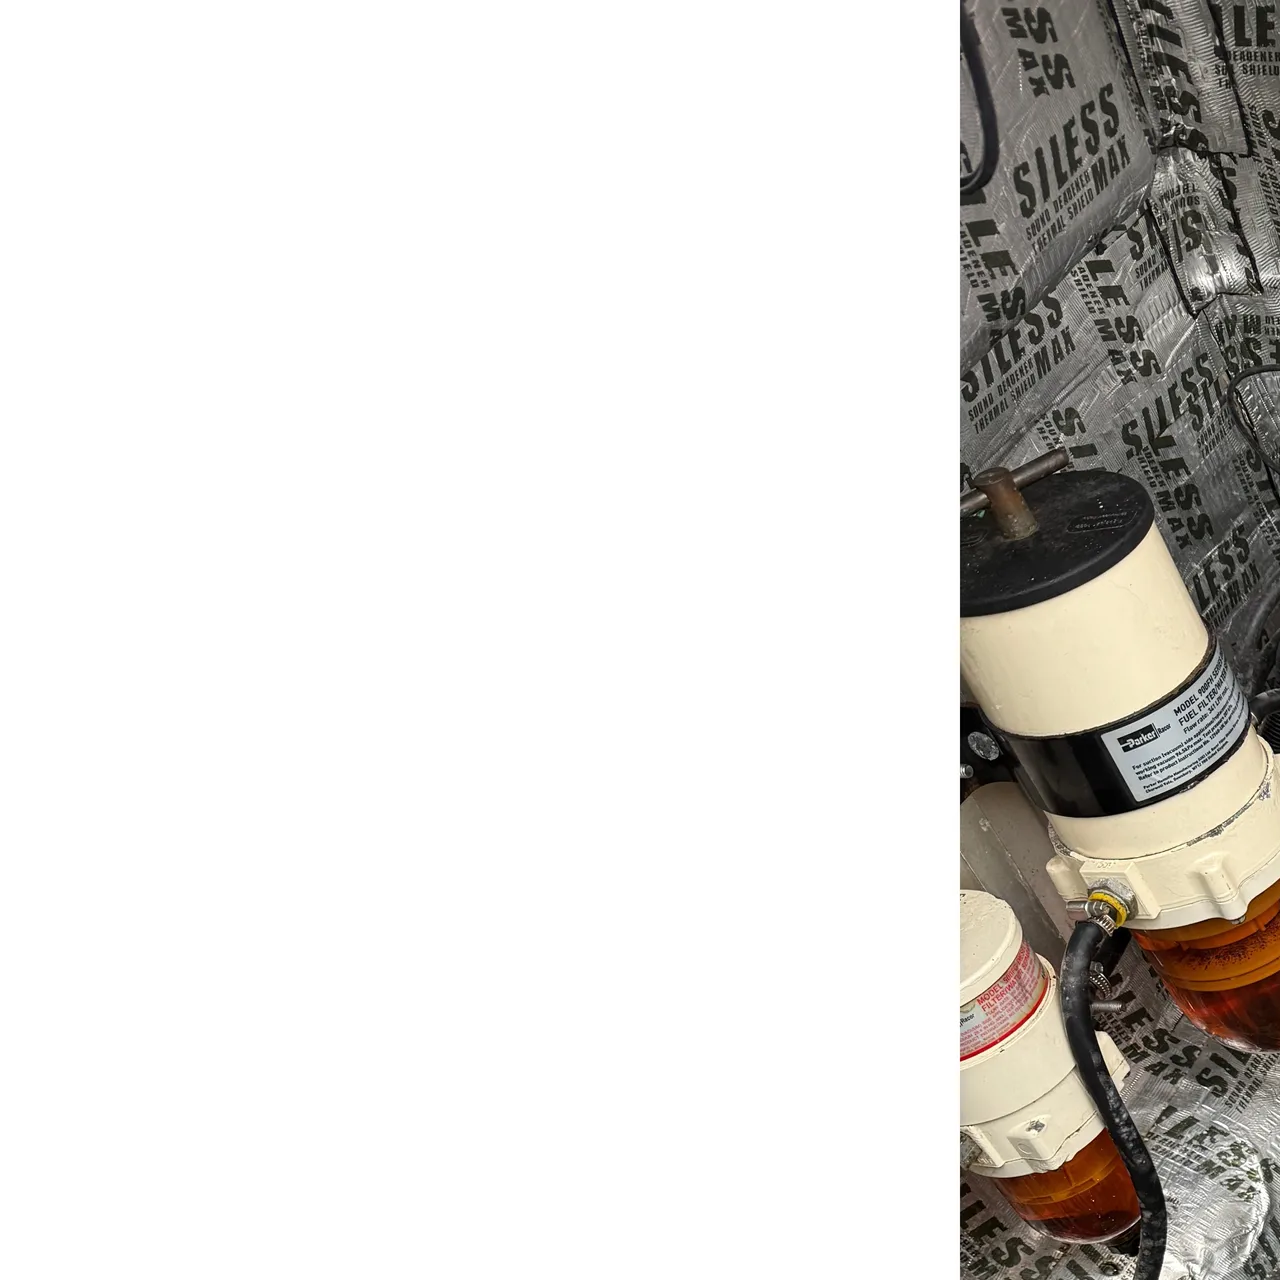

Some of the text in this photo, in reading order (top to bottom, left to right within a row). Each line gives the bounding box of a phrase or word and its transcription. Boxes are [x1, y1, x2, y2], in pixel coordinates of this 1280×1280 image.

[1001, 7, 1050, 98] MAX
[1228, 51, 1280, 63] EADENER
[1242, 64, 1280, 76] SHIELD
[1014, 82, 1119, 219] SILESS
[1026, 208, 1051, 241] SOUND
[1091, 134, 1131, 197] MAX
[1085, 259, 1161, 378] LESS
[968, 386, 994, 421] SOUND
[1034, 326, 1075, 380] MAX
[974, 400, 1009, 434] THERMAL
[1173, 693, 1198, 716] MODEL
[1178, 709, 1199, 726] FUEL
[1127, 723, 1171, 749] Parker Racor
[976, 983, 1003, 1005] MODEL
